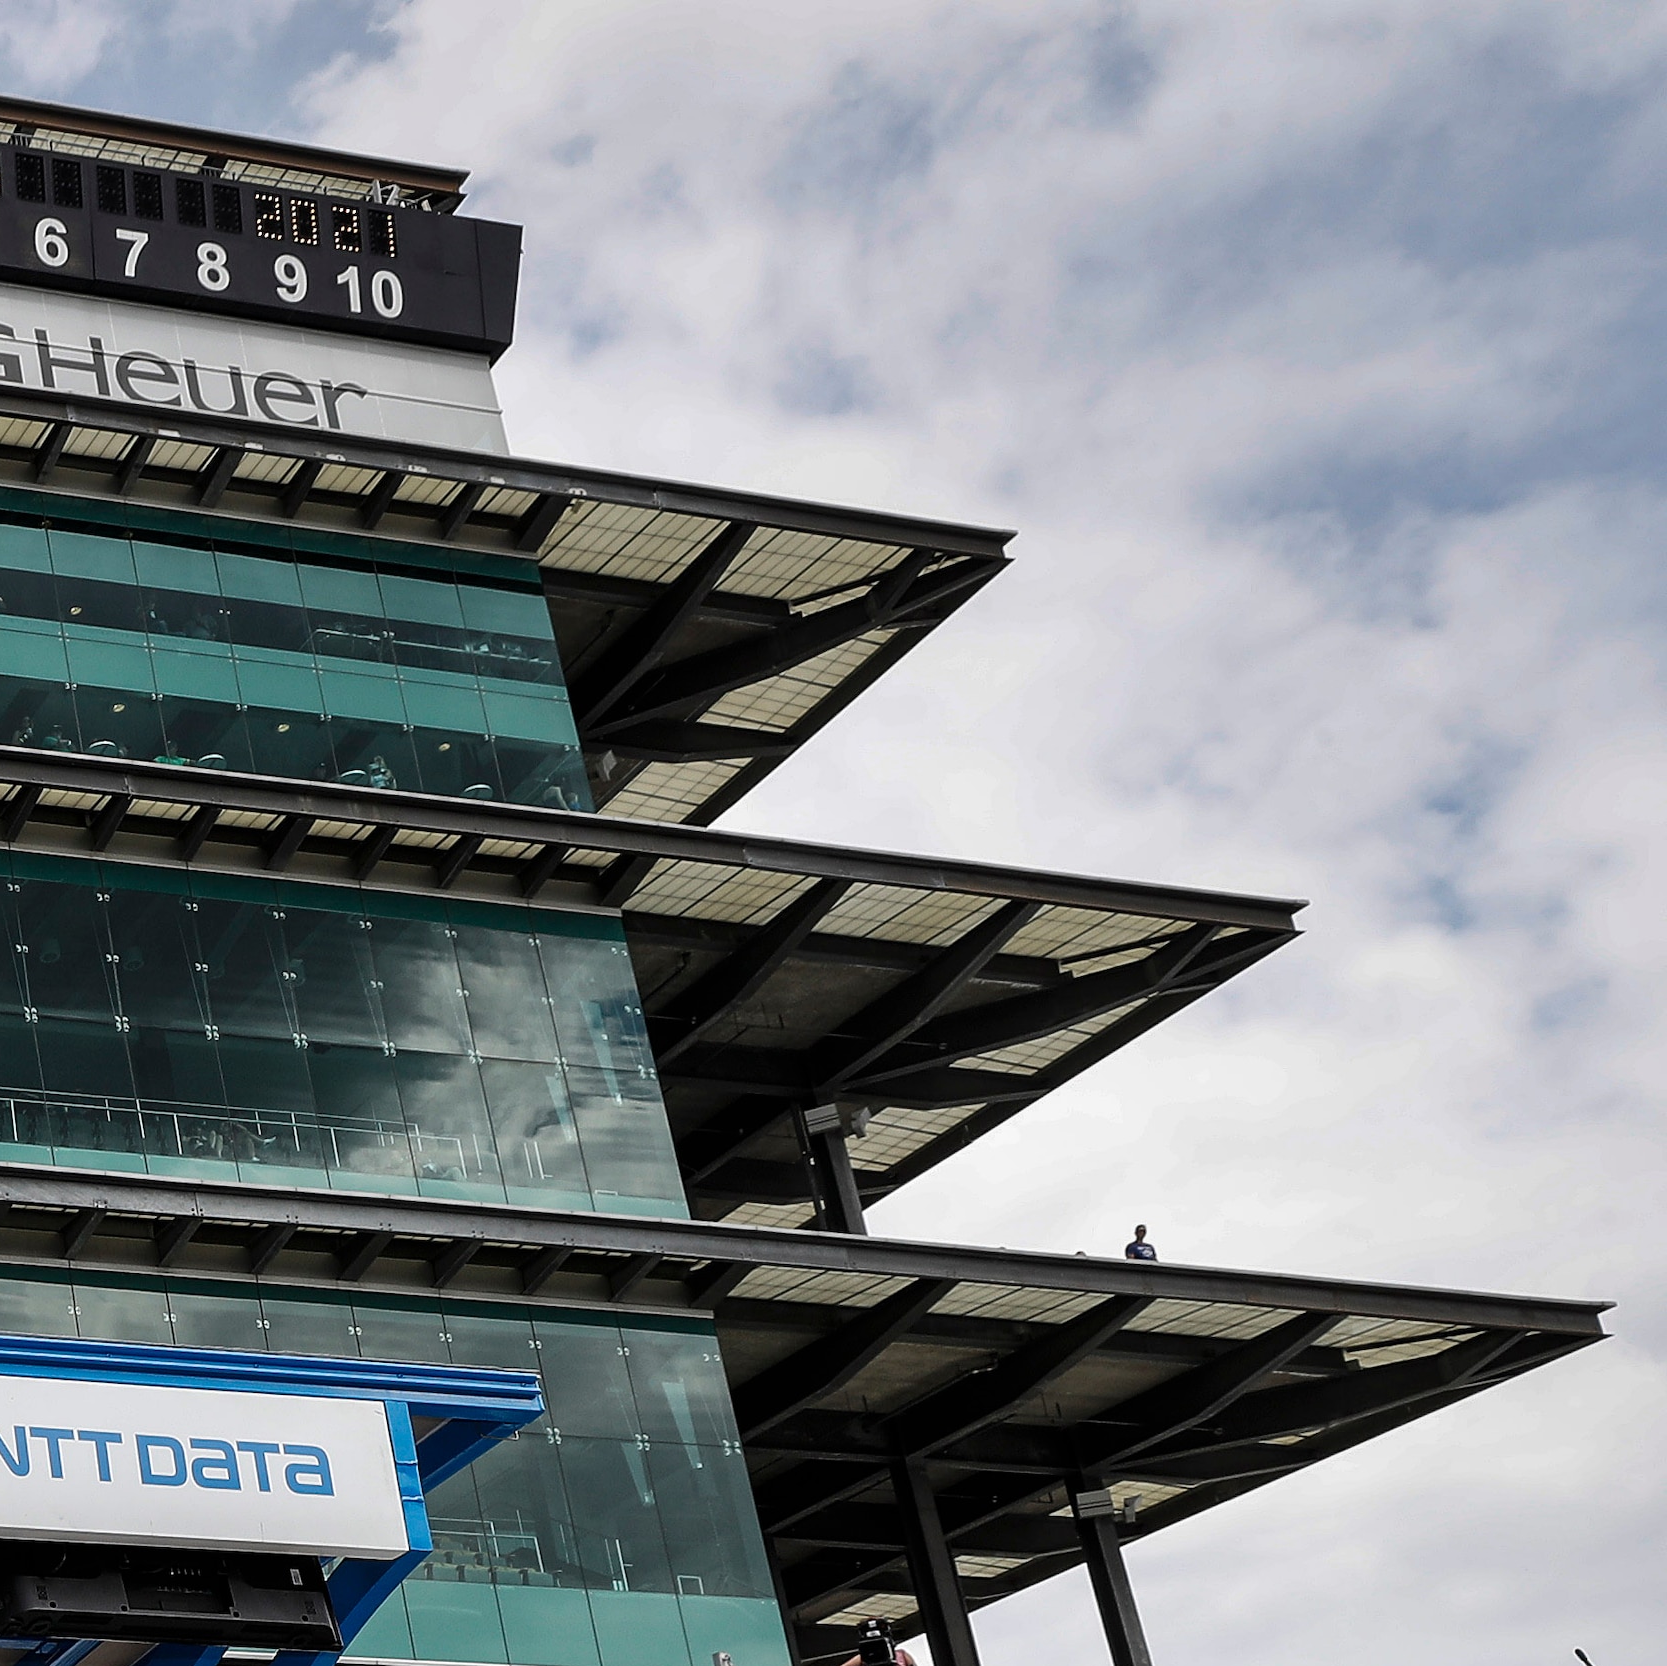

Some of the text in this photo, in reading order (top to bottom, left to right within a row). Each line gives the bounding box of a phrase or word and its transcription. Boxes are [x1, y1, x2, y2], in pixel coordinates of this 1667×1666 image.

[34, 217, 69, 267] 6
[115, 228, 149, 278] 7
[196, 242, 231, 292] 8
[273, 254, 308, 303] 9
[336, 265, 404, 319] 10
[254, 193, 397, 259] 2021
